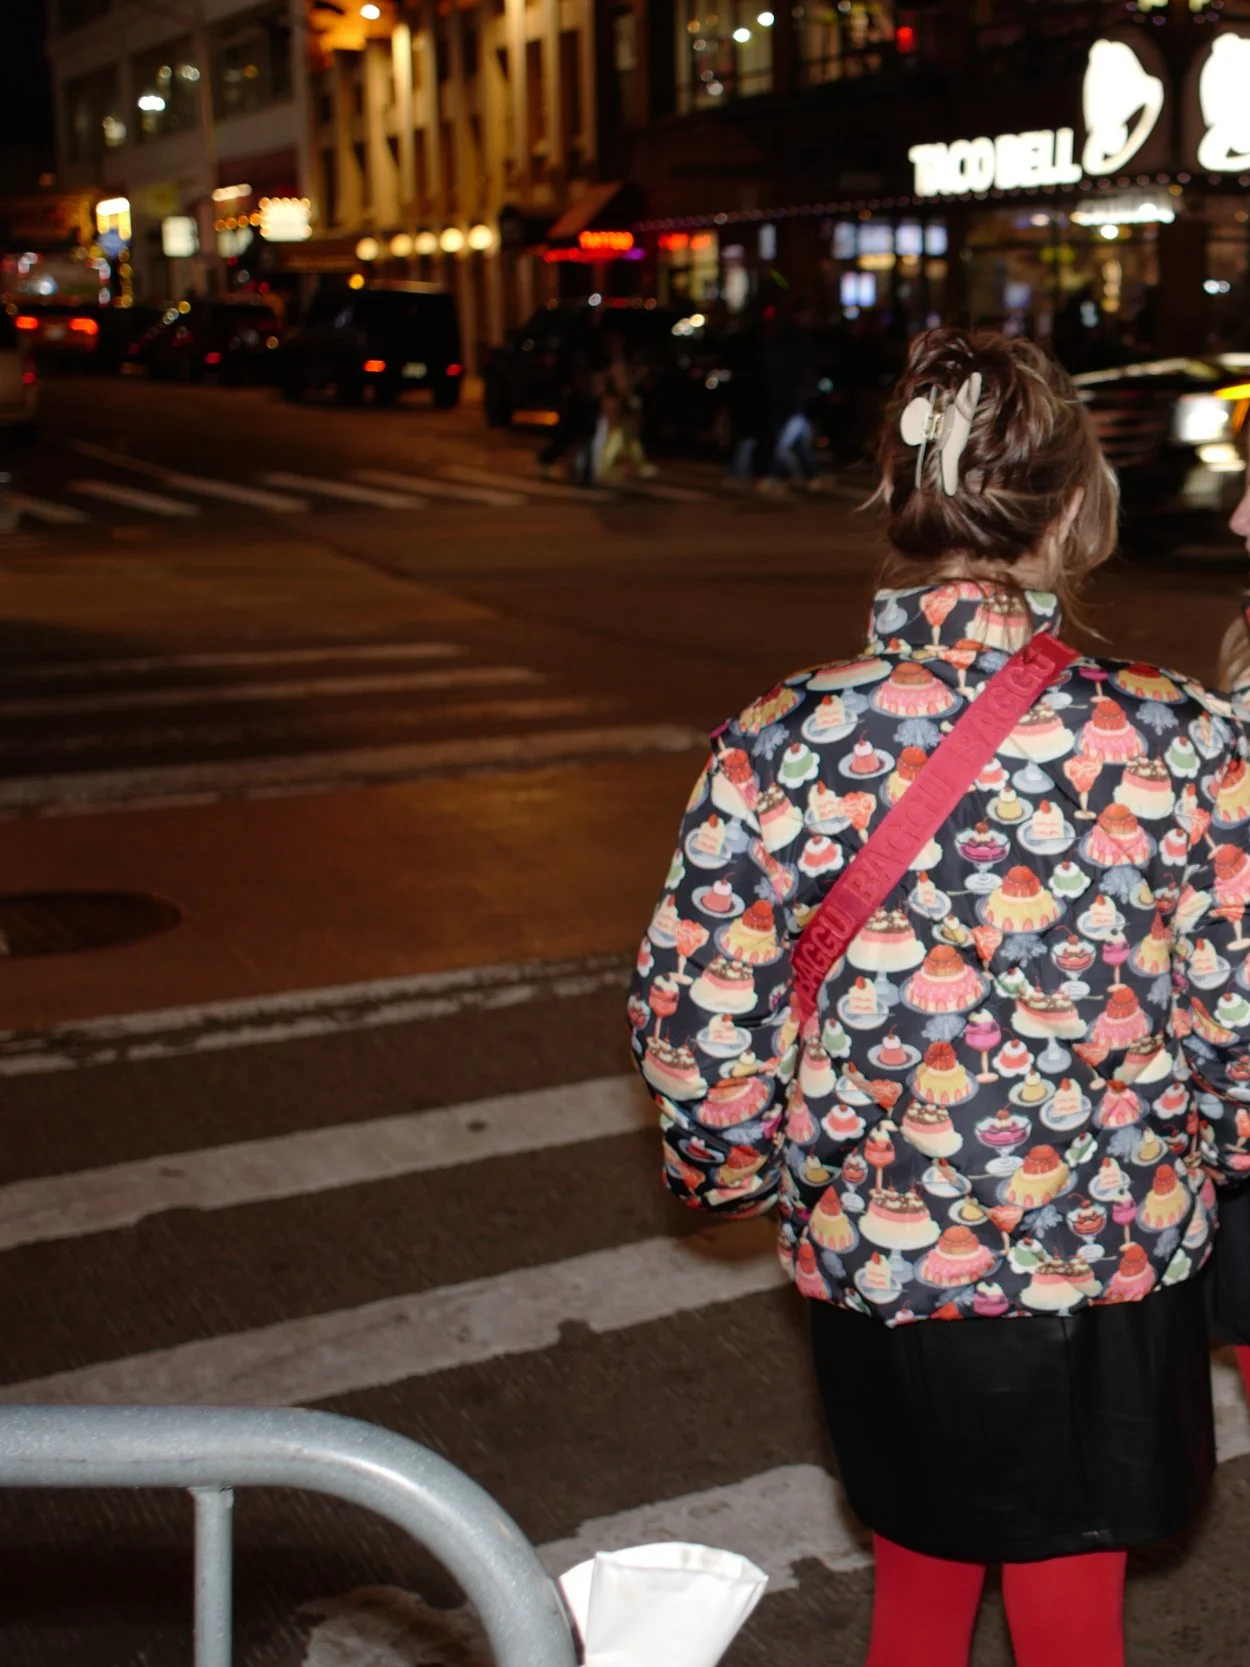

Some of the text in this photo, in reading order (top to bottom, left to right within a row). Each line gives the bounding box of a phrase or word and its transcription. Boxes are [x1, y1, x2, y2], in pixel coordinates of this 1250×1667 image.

[908, 127, 1083, 197] TACO BELL
[842, 770, 955, 907] BAGGU
[953, 647, 1056, 767] BAGGU
